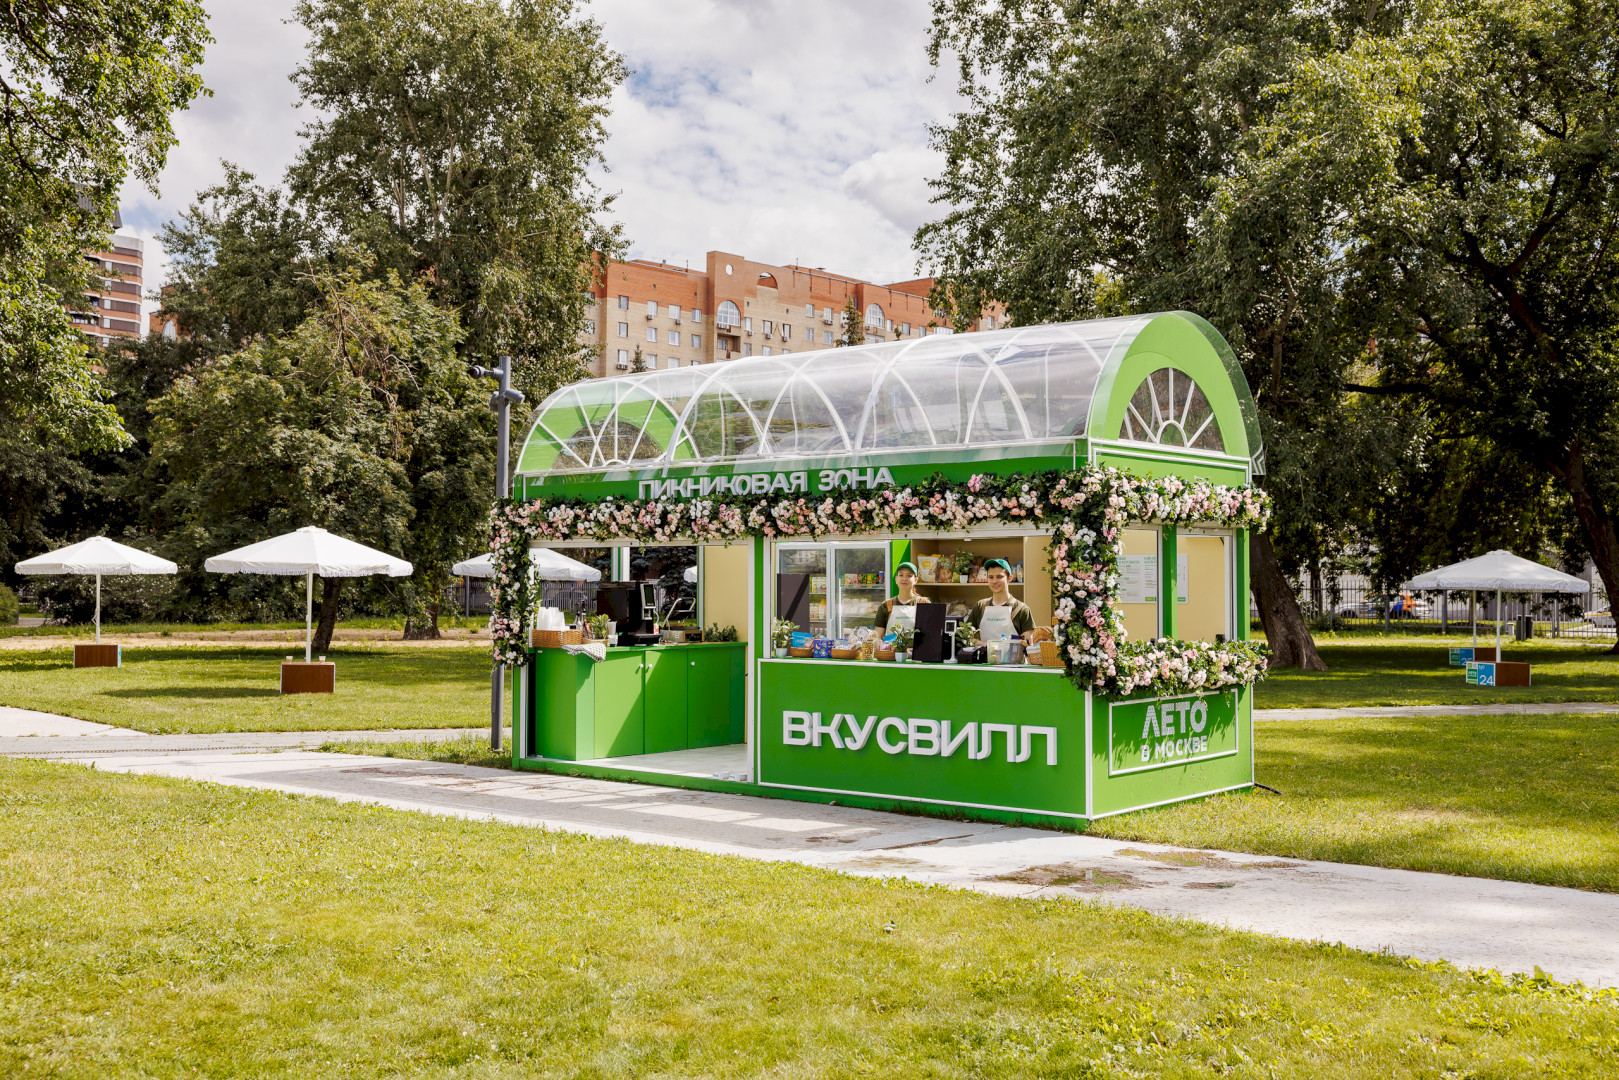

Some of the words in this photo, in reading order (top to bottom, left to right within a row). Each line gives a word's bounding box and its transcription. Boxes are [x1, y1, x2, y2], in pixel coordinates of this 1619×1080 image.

[638, 471, 808, 500] ПИКНИКОВАЯ
[818, 467, 896, 492] ЗОНА
[1479, 674, 1494, 686] 24
[1141, 700, 1208, 739] ЛЕТО
[782, 710, 1058, 766] ВКУСВИЛЛ
[1141, 744, 1151, 762] В
[1155, 735, 1208, 760] МОСКВЕ
